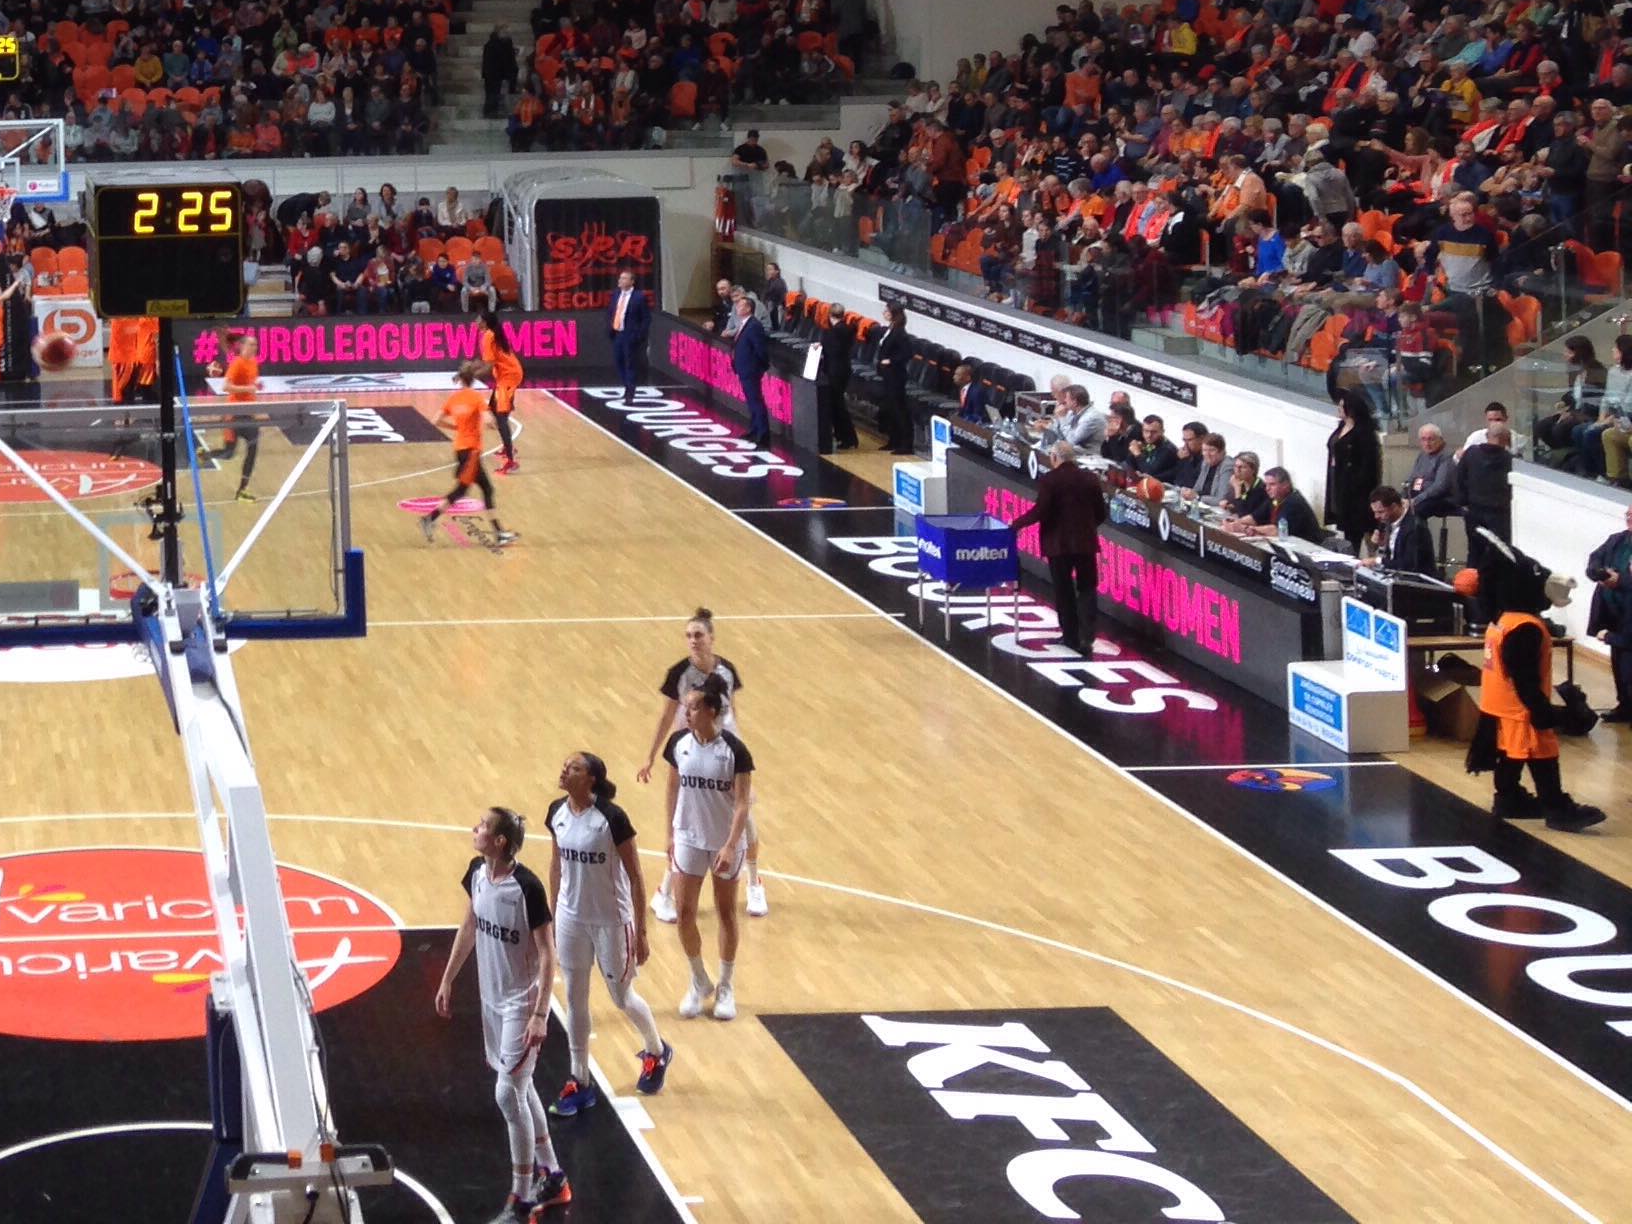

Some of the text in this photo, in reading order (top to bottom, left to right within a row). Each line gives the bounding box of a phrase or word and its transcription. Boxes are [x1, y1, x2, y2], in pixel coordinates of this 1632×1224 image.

[581, 386, 804, 479] BOURGES
[955, 547, 1009, 561] molten
[860, 1014, 1226, 1222] KFC
